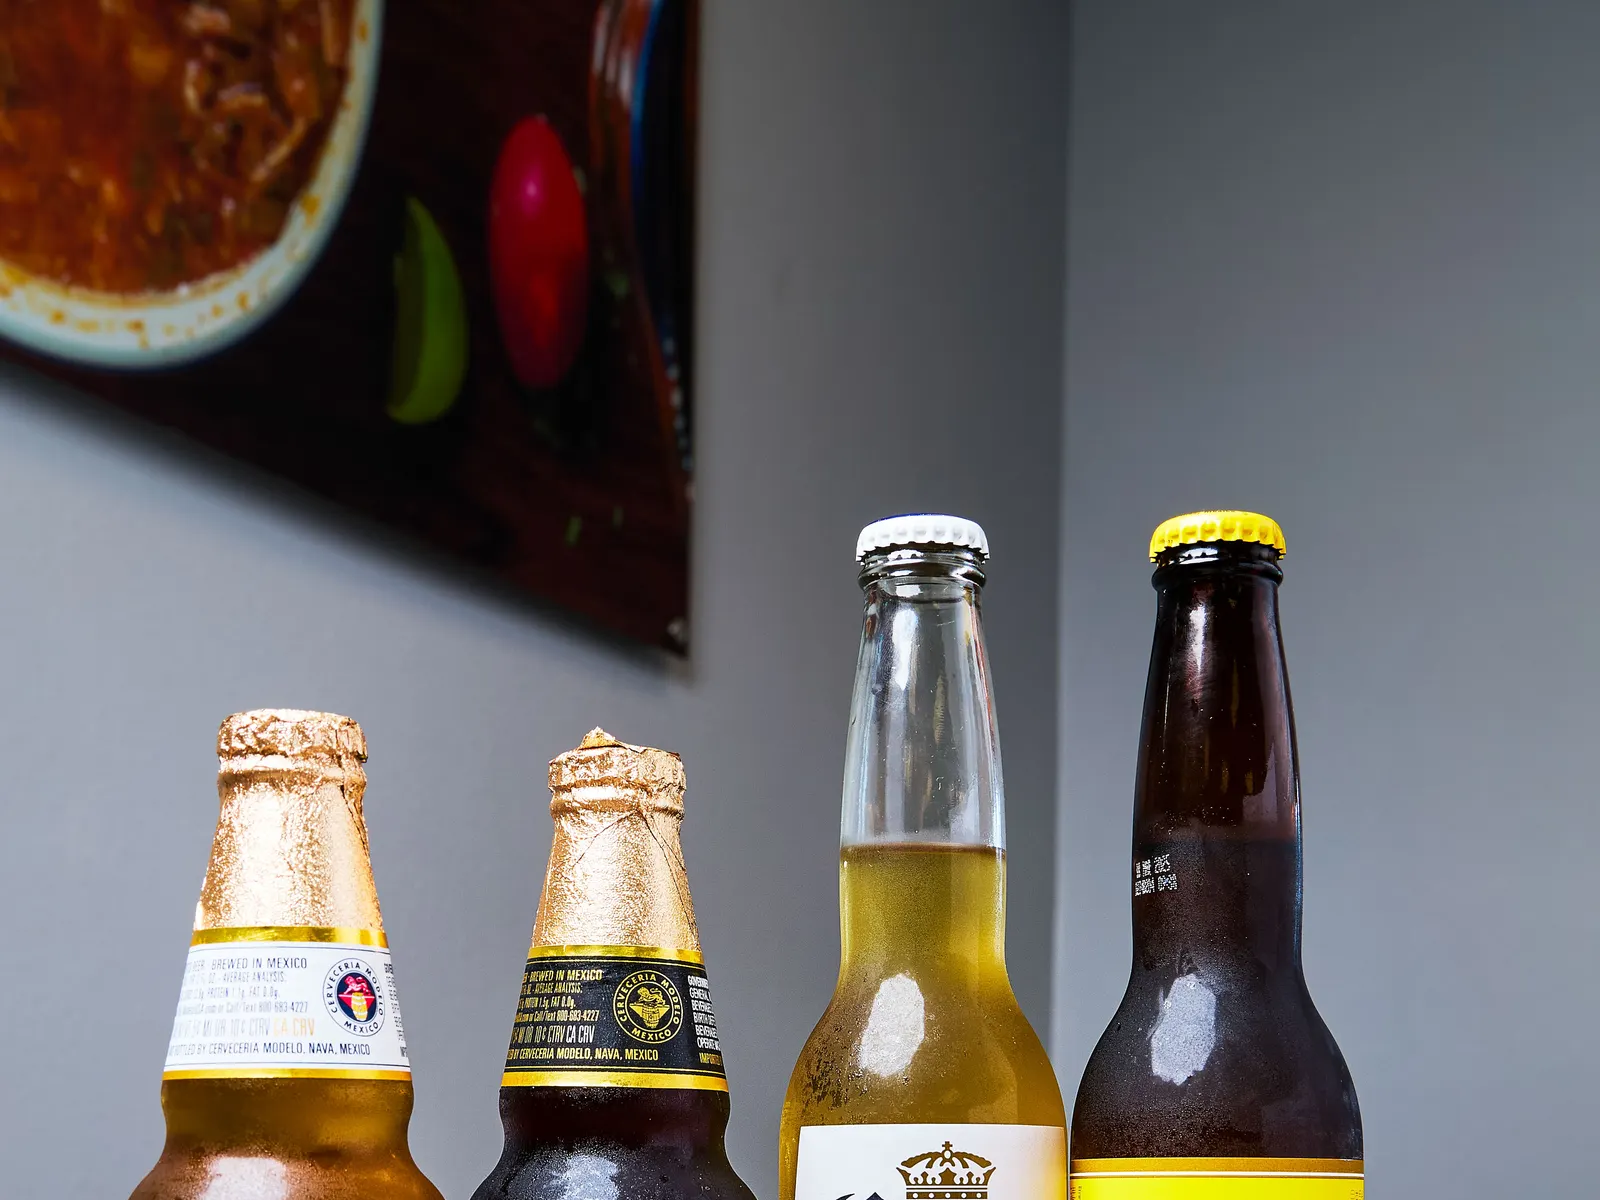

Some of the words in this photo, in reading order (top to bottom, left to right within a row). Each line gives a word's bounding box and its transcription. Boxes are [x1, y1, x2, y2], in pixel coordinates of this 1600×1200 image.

[211, 958, 248, 970] BREWED
[252, 957, 262, 969] IN
[267, 957, 307, 969] MEXICO
[529, 970, 554, 982] BREWED
[555, 969, 565, 981] IN
[566, 969, 604, 981] MEXICO
[327, 961, 361, 1013] CERVECERIA
[365, 968, 384, 1016] MODELO
[551, 996, 561, 1008] FAT
[617, 973, 657, 1022] CERVECERIA
[661, 979, 681, 1025] MODELO
[293, 1017, 315, 1037] CRV
[343, 1021, 379, 1034] MEXICO
[548, 1025, 566, 1043] CTRV
[566, 1025, 576, 1043] CA
[578, 1025, 595, 1043] CRV
[632, 1028, 672, 1041] MEXICO
[208, 1042, 260, 1055] CERVECERIA
[263, 1042, 306, 1054] MODELO,
[309, 1042, 338, 1055] NAVA,
[340, 1043, 371, 1055] MEXICO
[520, 1048, 554, 1060] CERVECERIA
[556, 1048, 593, 1060] MODELO,
[595, 1049, 623, 1061] NAVA,
[625, 1049, 659, 1061] MEXICO
